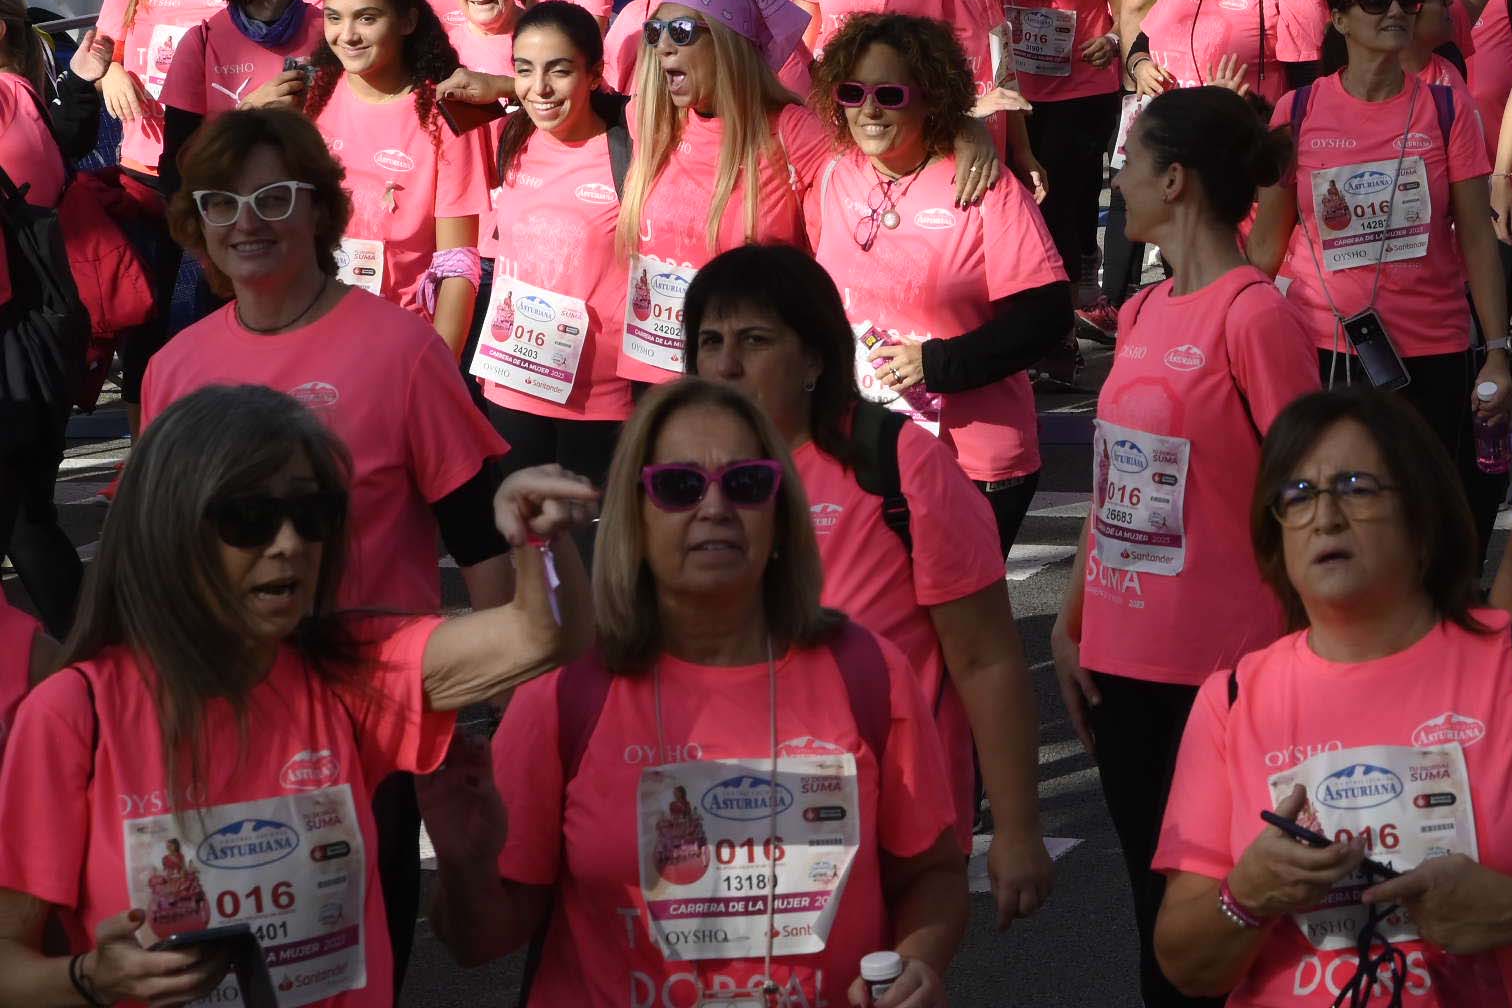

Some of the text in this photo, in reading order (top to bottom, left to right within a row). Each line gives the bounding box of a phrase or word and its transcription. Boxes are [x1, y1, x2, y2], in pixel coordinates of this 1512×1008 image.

[1024, 32, 1047, 43] 016
[1353, 200, 1391, 218] 016
[1333, 250, 1367, 262] OYSHO
[514, 325, 545, 347] 016
[513, 344, 538, 360] 24203
[1152, 454, 1178, 465] SUMA
[1107, 483, 1141, 506] 016
[1106, 507, 1133, 525] 26683
[1131, 549, 1174, 565] Santander
[1418, 725, 1480, 743] ASTURIANA
[625, 743, 702, 764] OYHO
[1410, 769, 1450, 782] SUMA
[802, 783, 842, 794] SUMA
[1323, 780, 1398, 802] ASTURIANA
[306, 816, 342, 832] SUMA
[206, 836, 293, 862] ASTURIANA
[716, 836, 785, 867] 016
[216, 881, 296, 920] 016
[670, 902, 725, 916] CARRERA
[729, 901, 745, 913] DE
[748, 900, 764, 912] LA
[665, 929, 729, 946] OYSHO
[279, 943, 319, 960] MUJER
[295, 962, 348, 988] Santander
